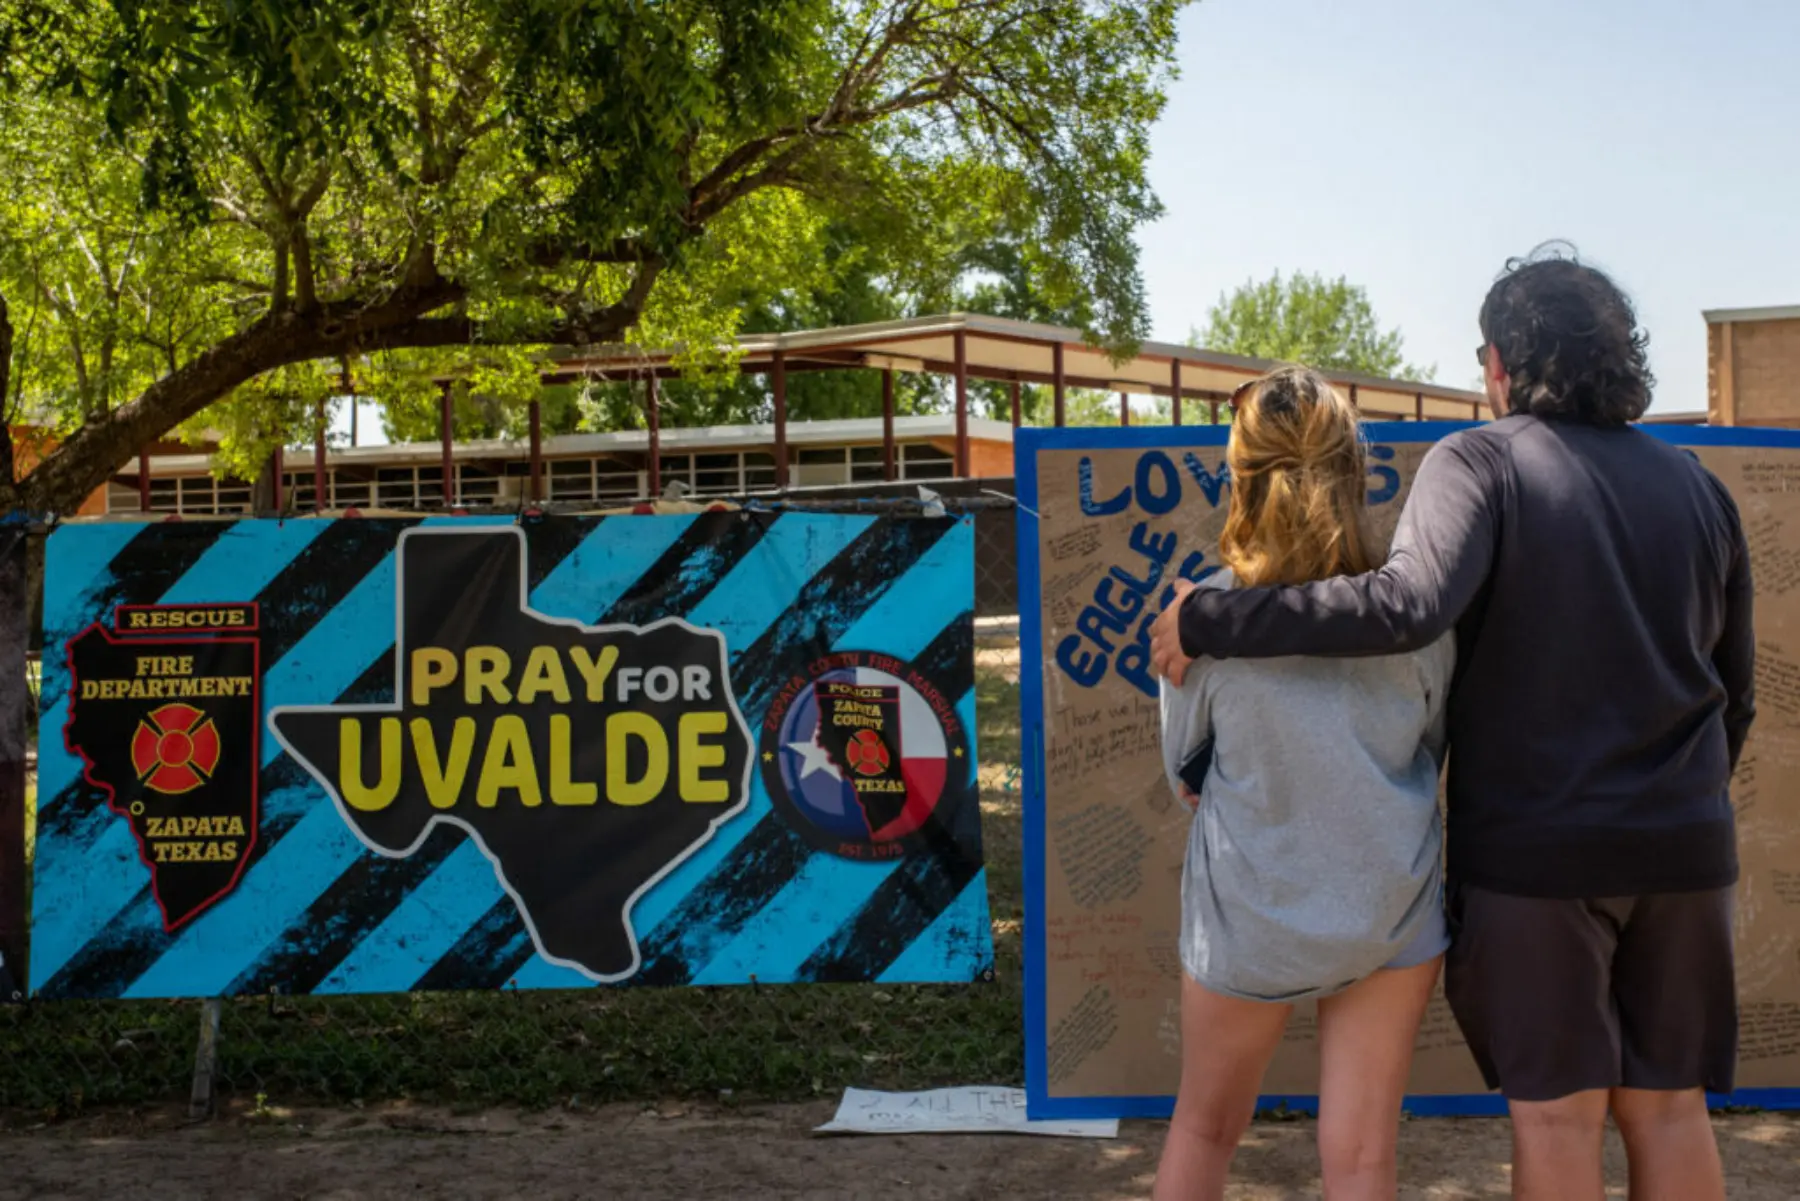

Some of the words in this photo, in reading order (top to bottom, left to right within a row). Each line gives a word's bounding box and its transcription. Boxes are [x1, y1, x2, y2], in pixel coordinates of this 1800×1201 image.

[1055, 521, 1178, 688] EAGLE
[129, 609, 246, 629] RESCUE
[135, 655, 195, 676] FIRE
[410, 645, 620, 706] PRAY
[616, 665, 712, 703] FOR
[868, 654, 903, 676] FIRE
[80, 676, 253, 699] DEPARTMENT
[339, 711, 731, 812] UVALDE
[854, 779, 906, 793] TEXAS
[146, 815, 246, 838] ZAPATA
[153, 841, 238, 863] TEXAS
